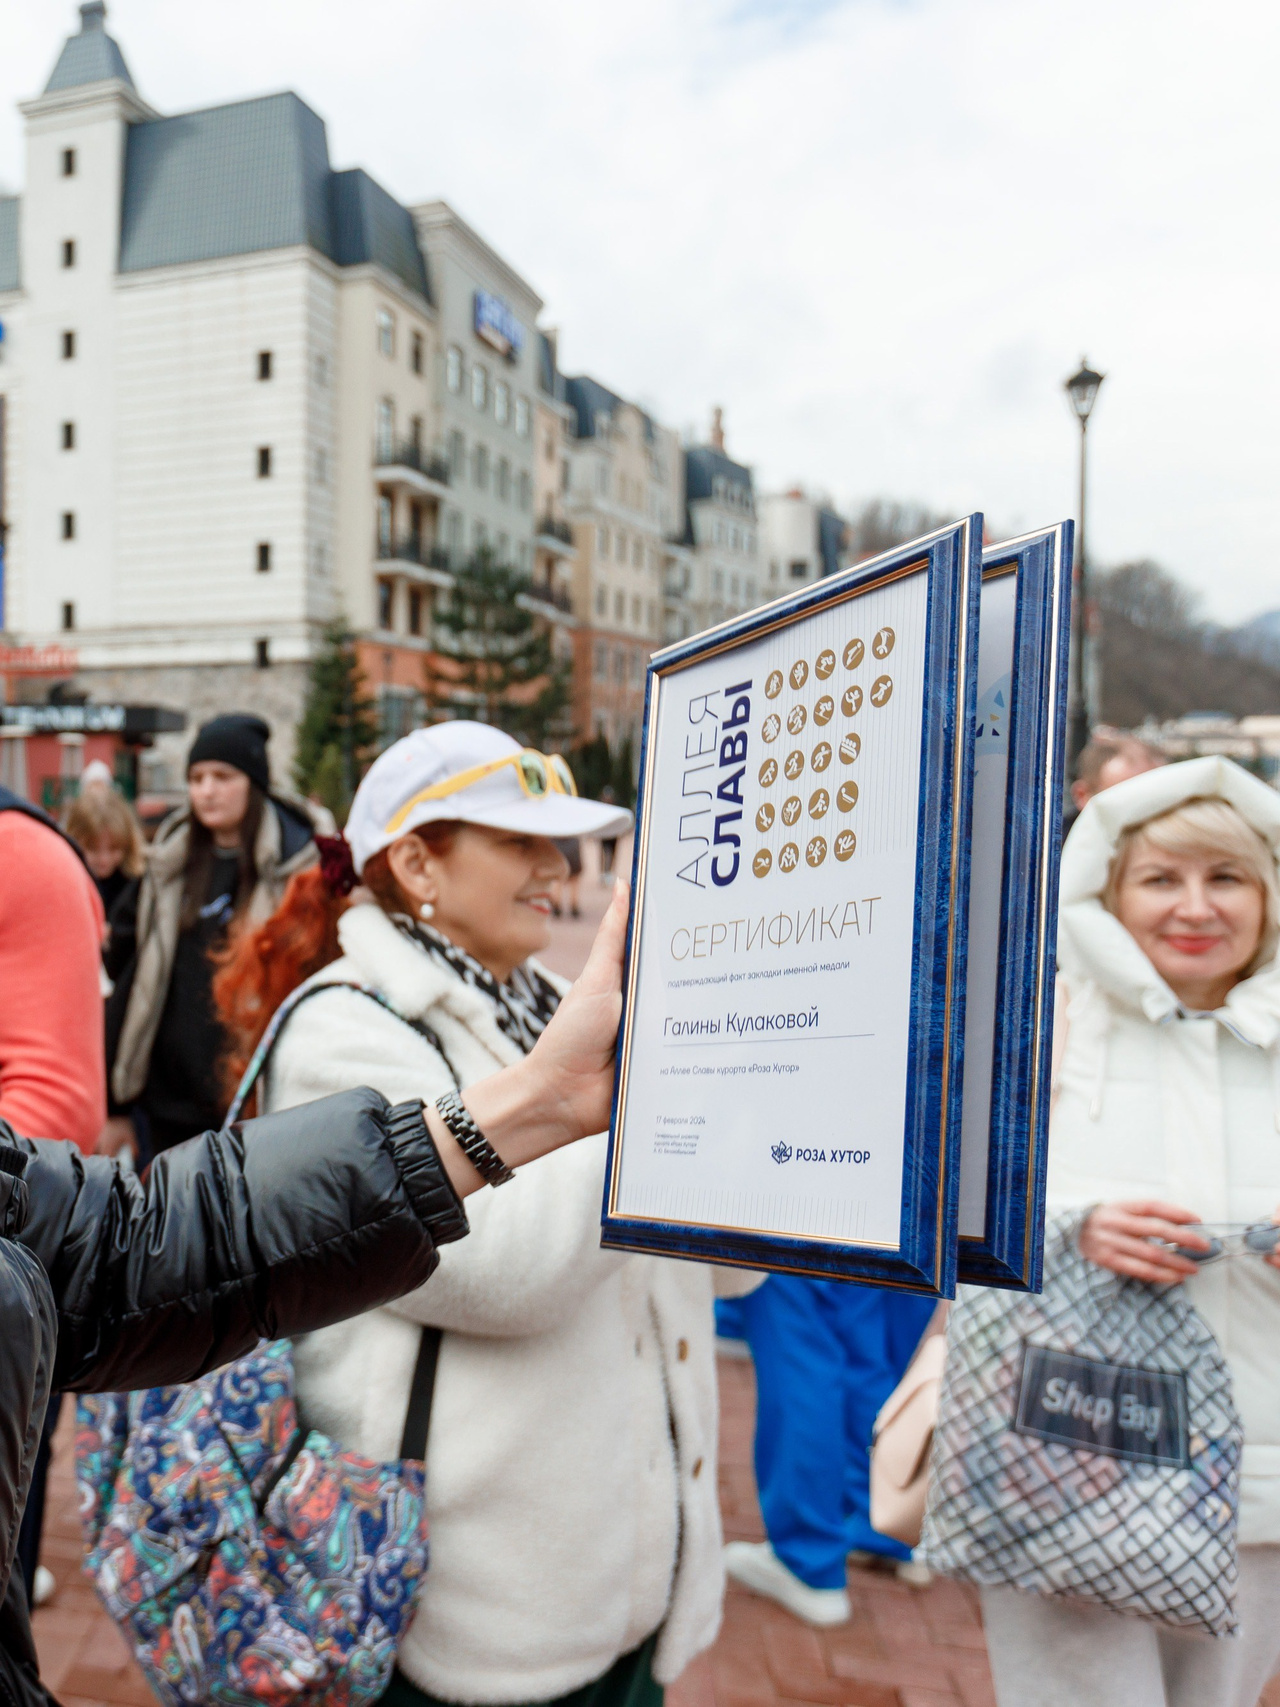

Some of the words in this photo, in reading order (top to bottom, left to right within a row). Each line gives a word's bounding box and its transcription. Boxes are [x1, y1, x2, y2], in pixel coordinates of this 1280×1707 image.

[676, 690, 721, 889] АЛЛЕЯ
[711, 679, 753, 887] СЛАВЫ
[670, 896, 882, 961] СЕРТИФИКАТ
[667, 973, 728, 988] подтверждающий
[729, 972, 747, 984] факт
[747, 968, 782, 979] закладки
[783, 962, 818, 976] именной
[819, 961, 851, 972] медали
[663, 1016, 721, 1037] Галины
[726, 1005, 820, 1037] Кулаковой
[670, 1065, 691, 1076] Аллее
[692, 1065, 716, 1075] Славы
[716, 1065, 747, 1077] курорта
[748, 1063, 771, 1074] «Роза
[772, 1062, 800, 1075] Хутор»
[656, 1115, 663, 1124] 17
[663, 1115, 689, 1126] февраля
[689, 1115, 706, 1125] 2024
[796, 1148, 827, 1162] РОЗА
[830, 1149, 871, 1164] ХУТОР
